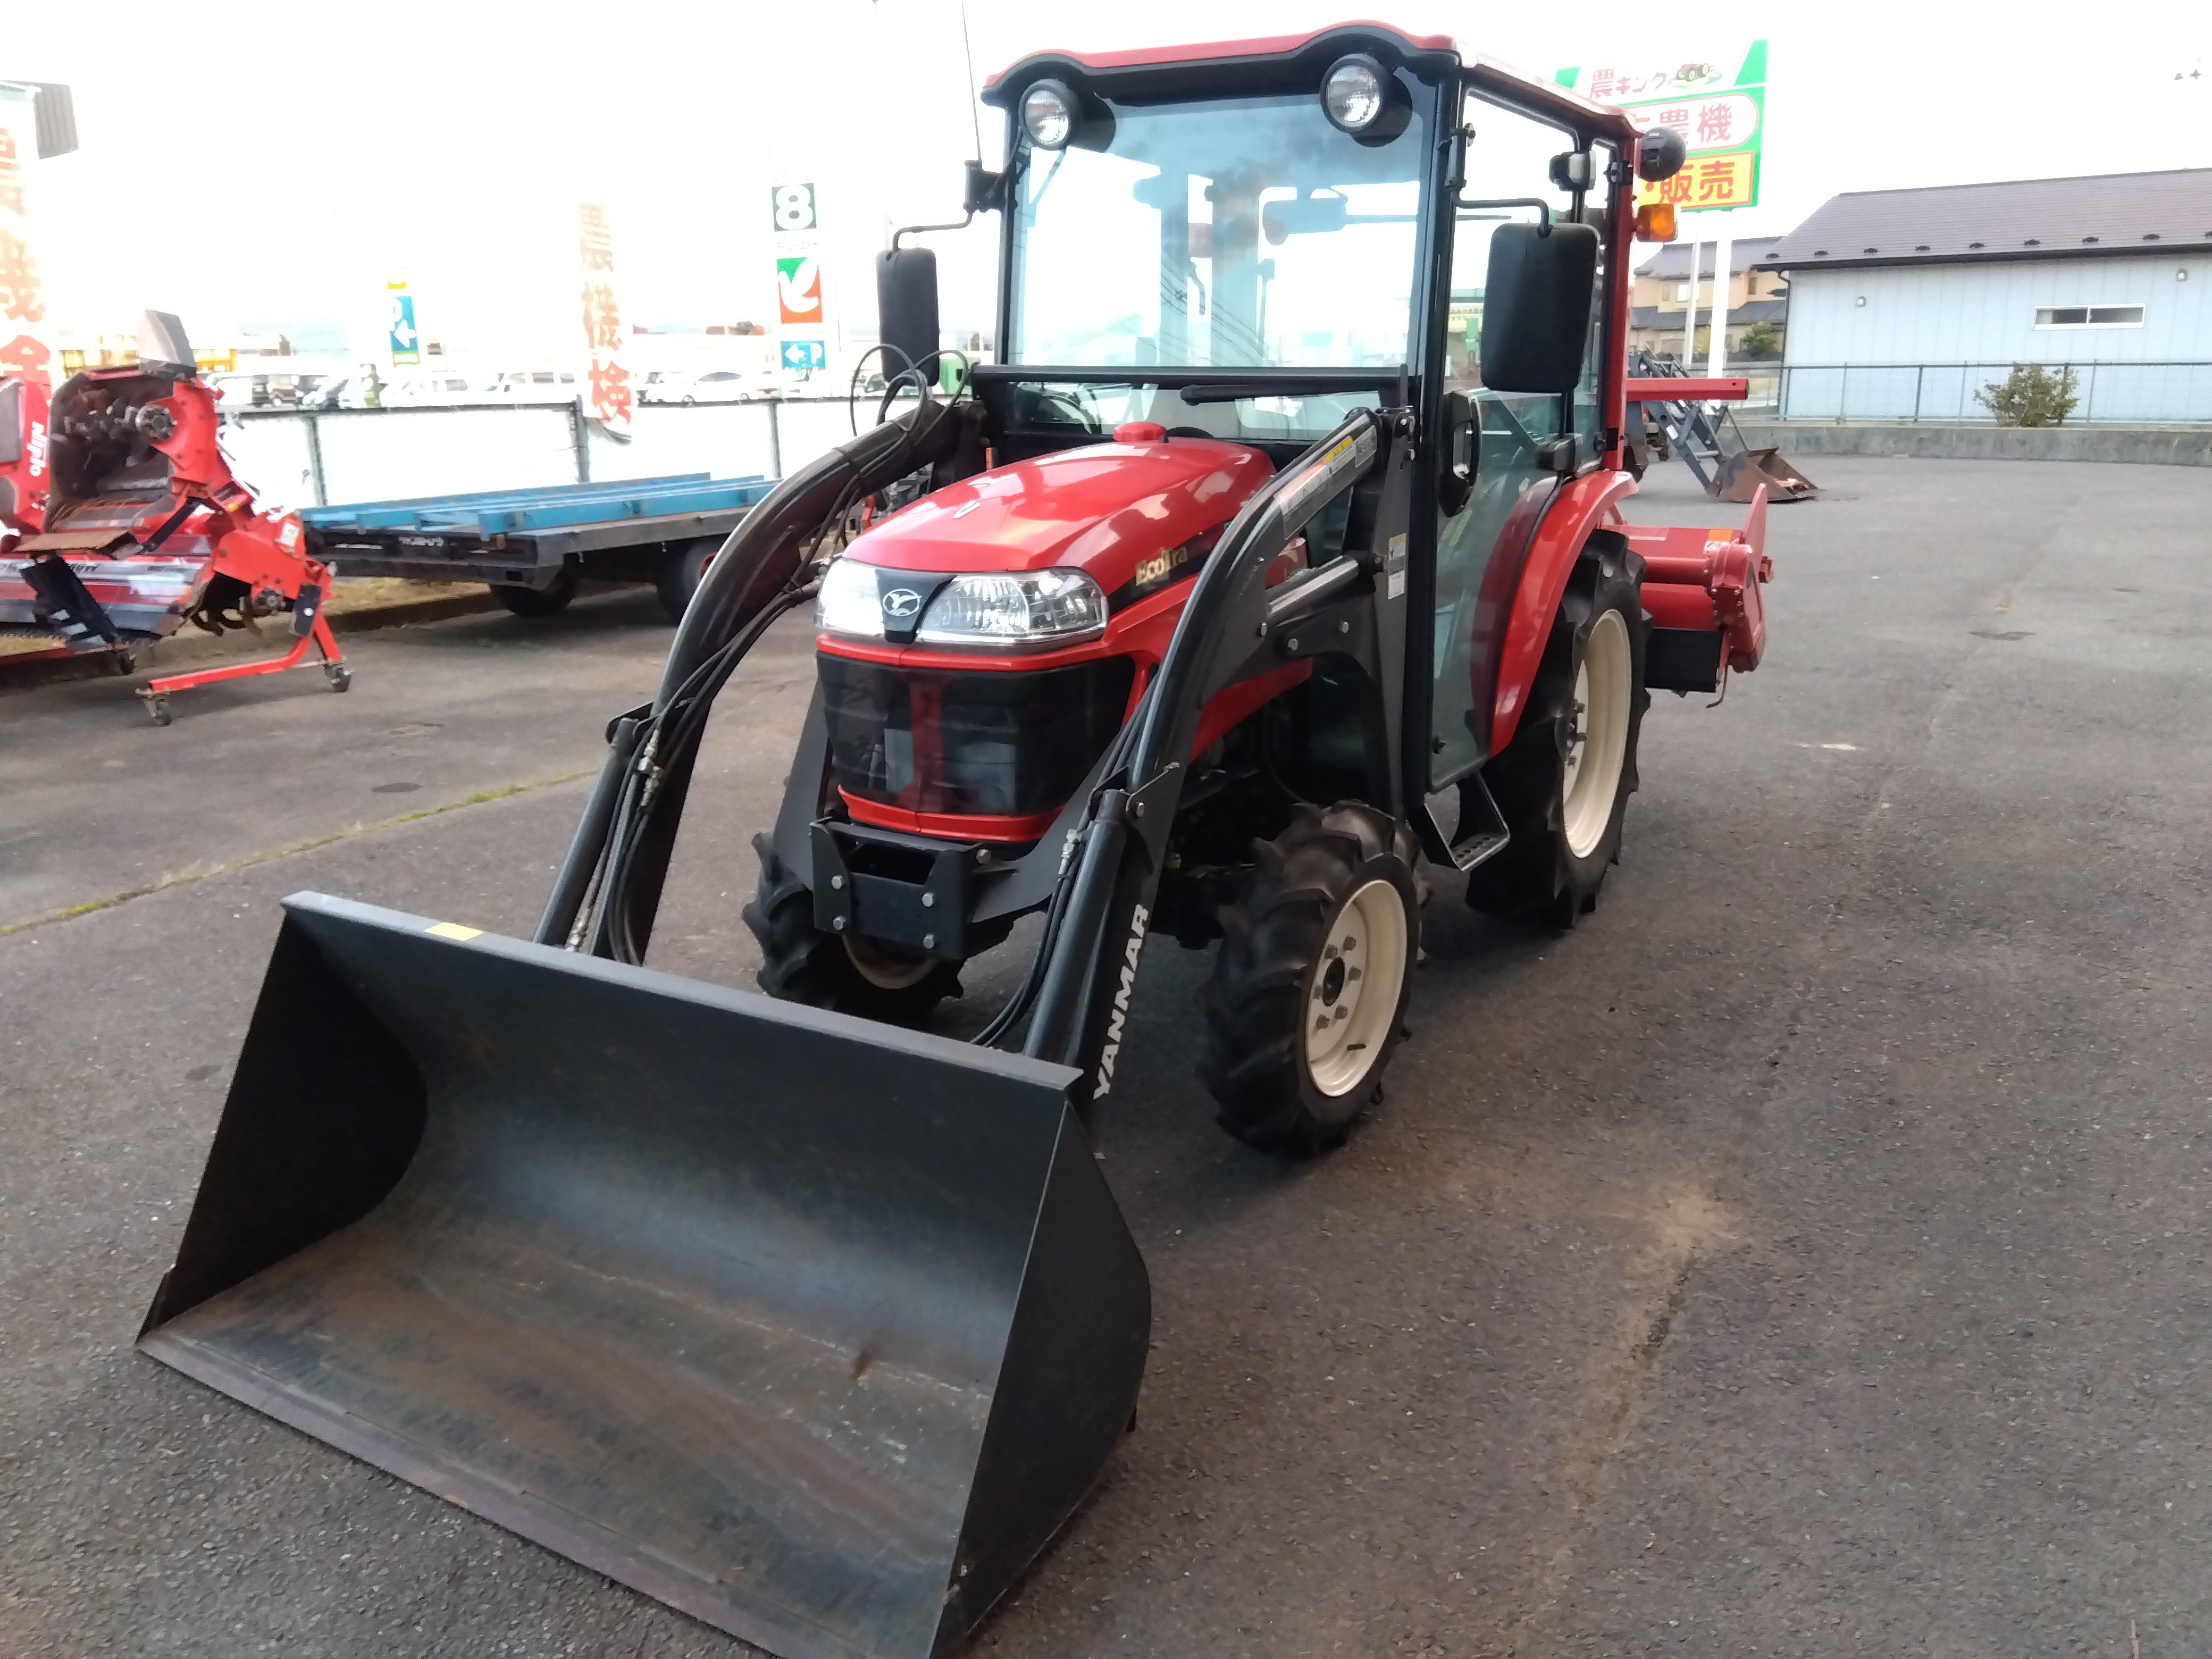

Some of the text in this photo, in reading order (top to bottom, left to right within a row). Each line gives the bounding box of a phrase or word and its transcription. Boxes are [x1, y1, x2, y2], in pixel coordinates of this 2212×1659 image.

[775, 183, 813, 230] 8
[809, 342, 823, 364] P
[1092, 903, 1149, 1100] YANMAR
